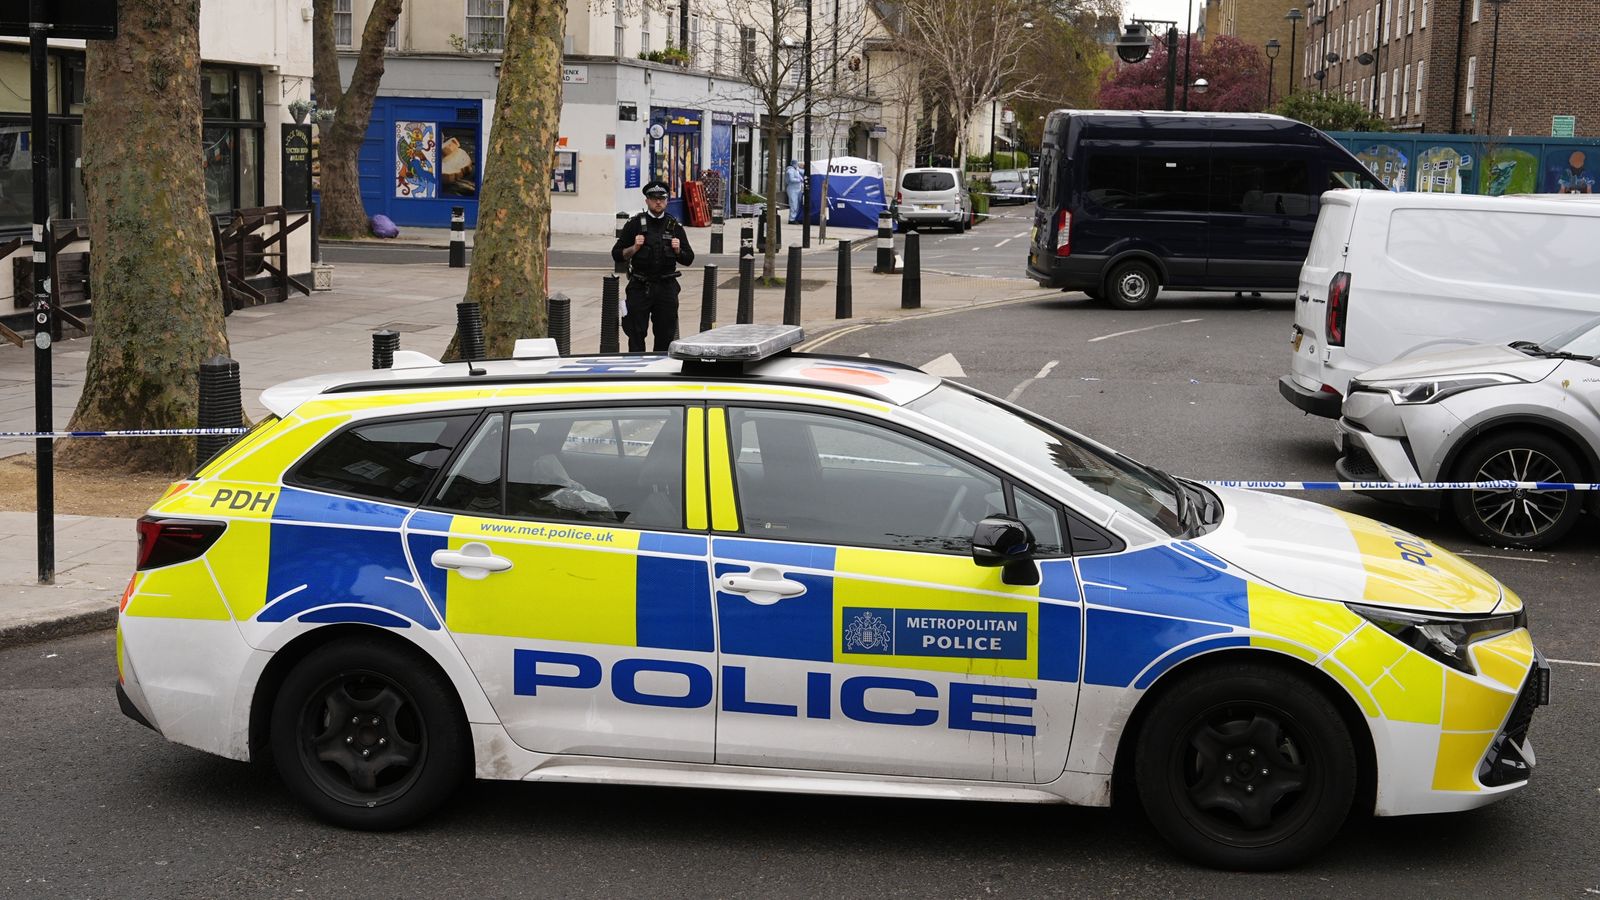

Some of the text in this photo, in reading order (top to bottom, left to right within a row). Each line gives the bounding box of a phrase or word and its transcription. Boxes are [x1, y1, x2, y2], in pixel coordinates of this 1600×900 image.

[829, 165, 858, 174] MPS
[210, 488, 276, 512] PDH
[480, 523, 614, 542] www.met.police.uk
[906, 617, 1018, 632] METROPOLITAN
[922, 635, 1002, 650] POLICE
[513, 648, 1038, 736] POLICE
